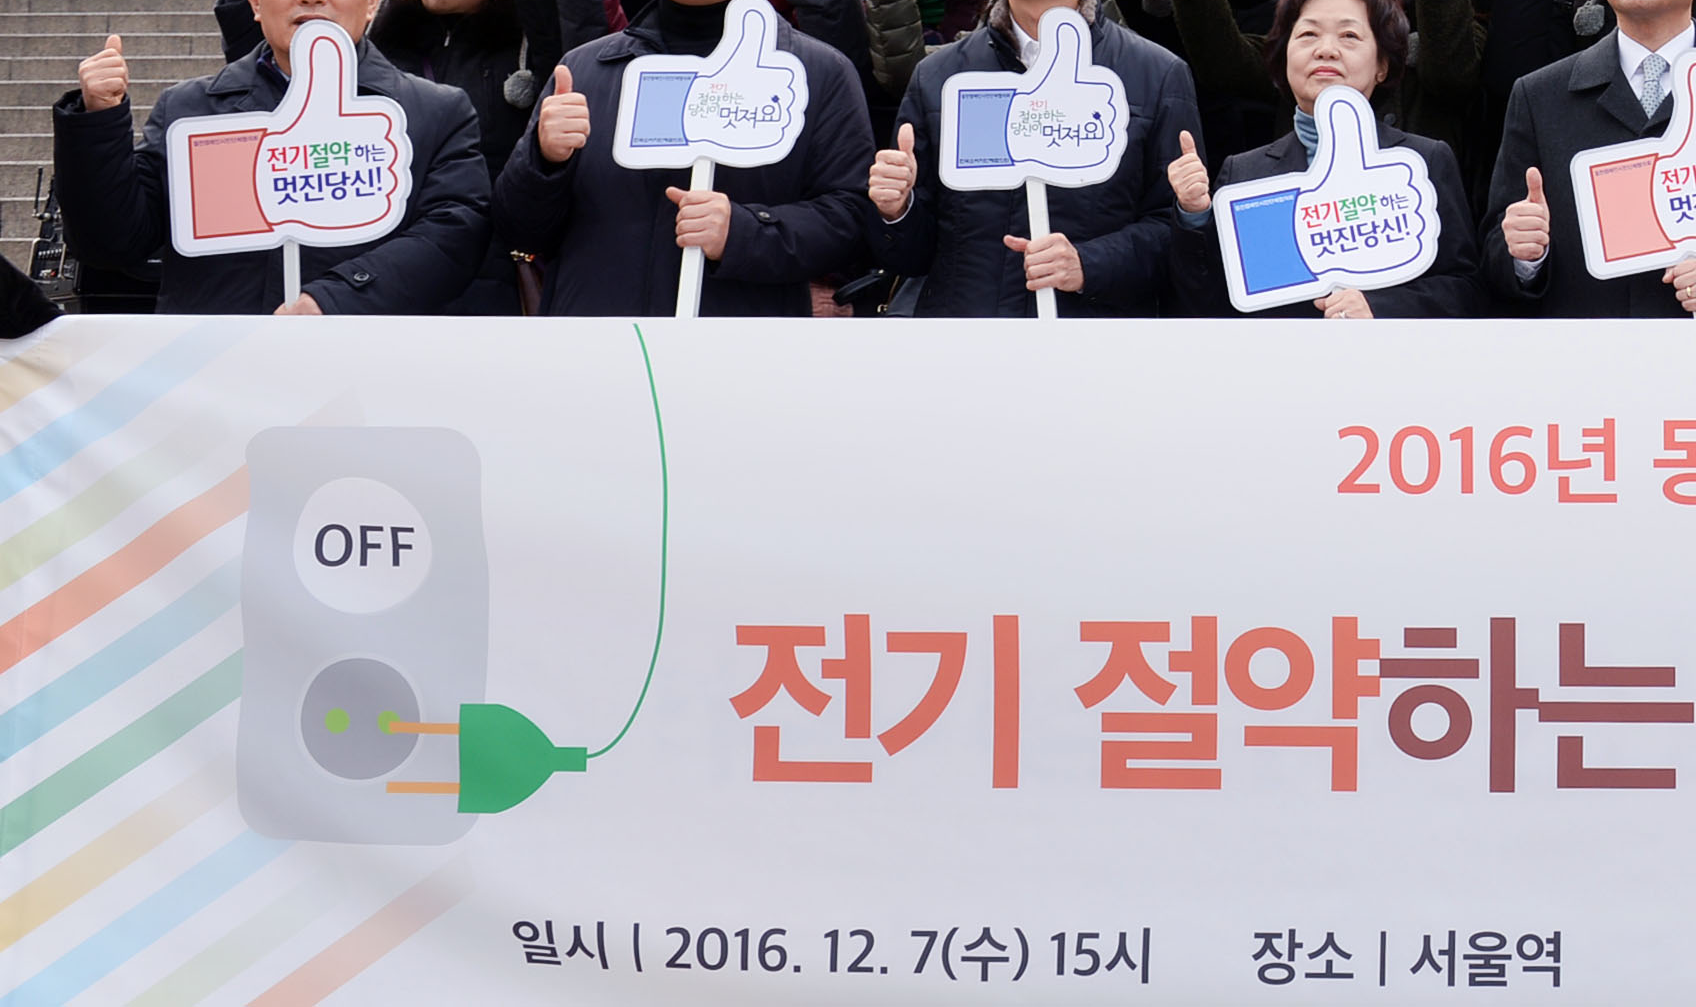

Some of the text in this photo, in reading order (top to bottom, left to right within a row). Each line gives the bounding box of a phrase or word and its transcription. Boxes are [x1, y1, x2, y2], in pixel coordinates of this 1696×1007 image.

[267, 141, 351, 173] 전기절약
[354, 144, 387, 163] 하는
[273, 166, 383, 206] 멋진당신!
[1300, 193, 1379, 229] 전기절약
[1380, 193, 1409, 211] 하는
[1310, 213, 1411, 258] 멋진당신!
[1337, 418, 1617, 503] 2016년
[315, 524, 415, 567] OFF
[729, 614, 1019, 789] 전기
[1074, 616, 1694, 793] 절약하는
[512, 920, 609, 970] 일시
[665, 927, 801, 973] 2016.
[824, 929, 888, 975] 12.
[911, 926, 1029, 982] 7(수)
[1051, 928, 1151, 984] 15시
[1252, 929, 1355, 986] 장소
[1410, 930, 1562, 988] 서울역
